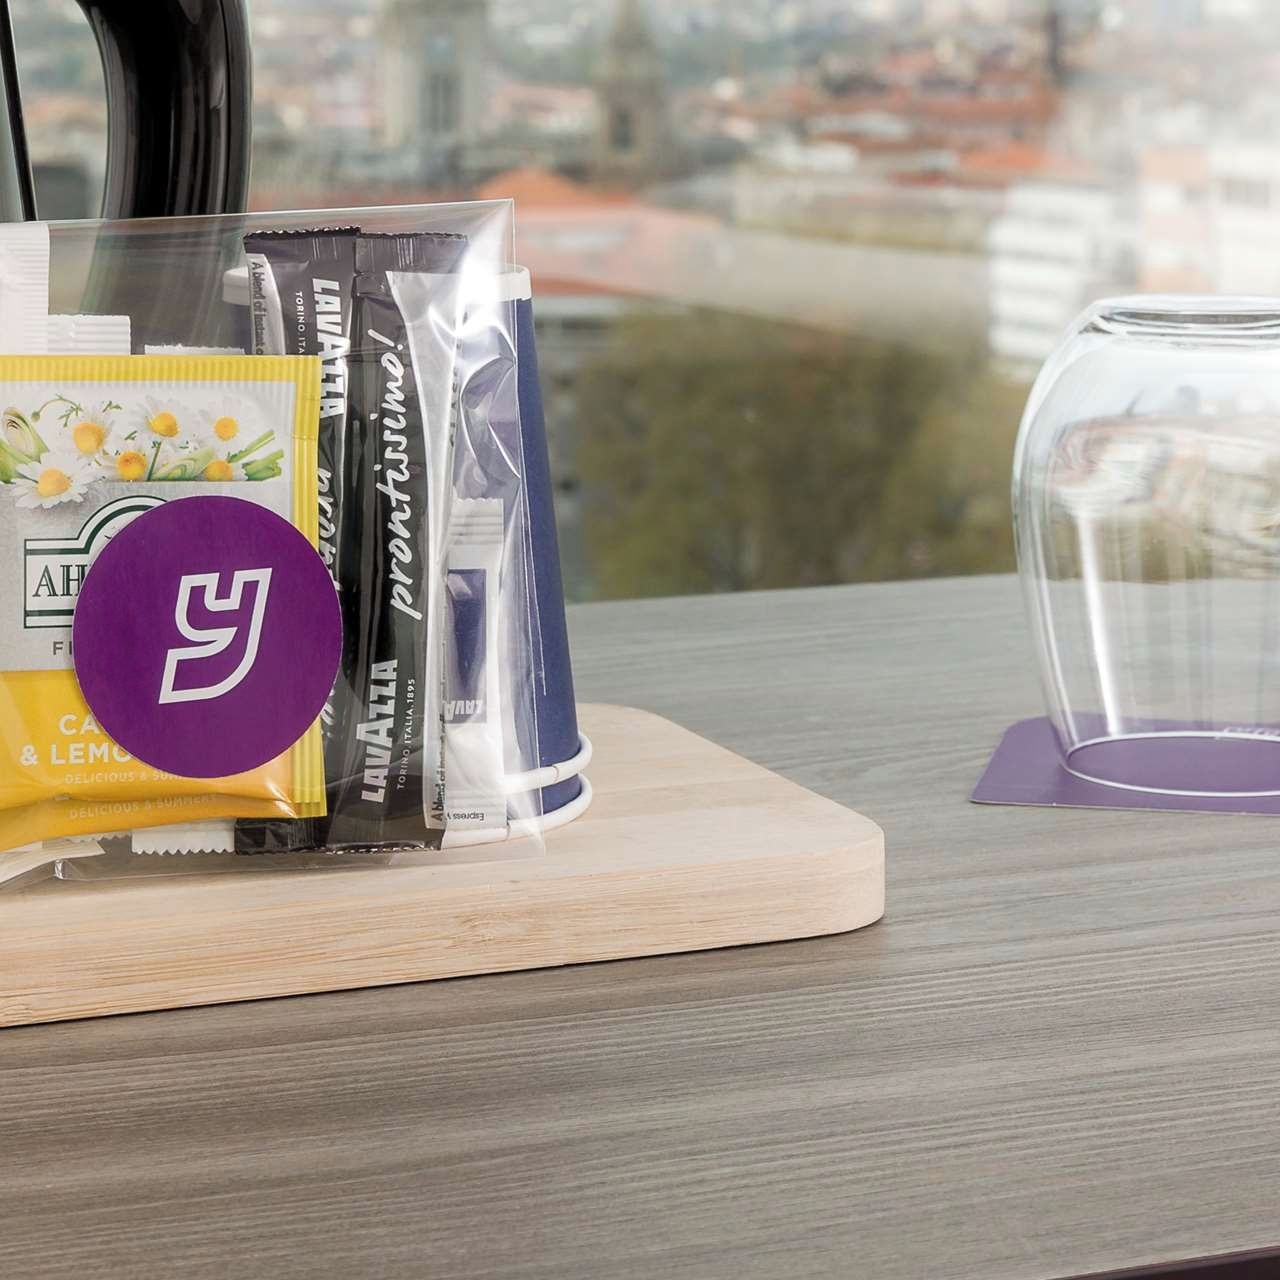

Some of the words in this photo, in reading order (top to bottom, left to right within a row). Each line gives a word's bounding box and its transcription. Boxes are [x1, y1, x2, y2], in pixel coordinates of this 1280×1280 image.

[253, 272, 266, 299] blend
[297, 337, 306, 354] ITA
[312, 278, 351, 419] LAVAZZA
[368, 328, 423, 621] prontissimo!
[32, 564, 87, 597] AH
[445, 699, 484, 721] LAVA
[59, 714, 103, 736] CA
[356, 659, 399, 803] LAVAZZA
[20, 744, 39, 766] &
[51, 742, 133, 766] LEMO
[64, 770, 135, 785] DELICIOUS
[69, 801, 139, 819] DELICIOUS
